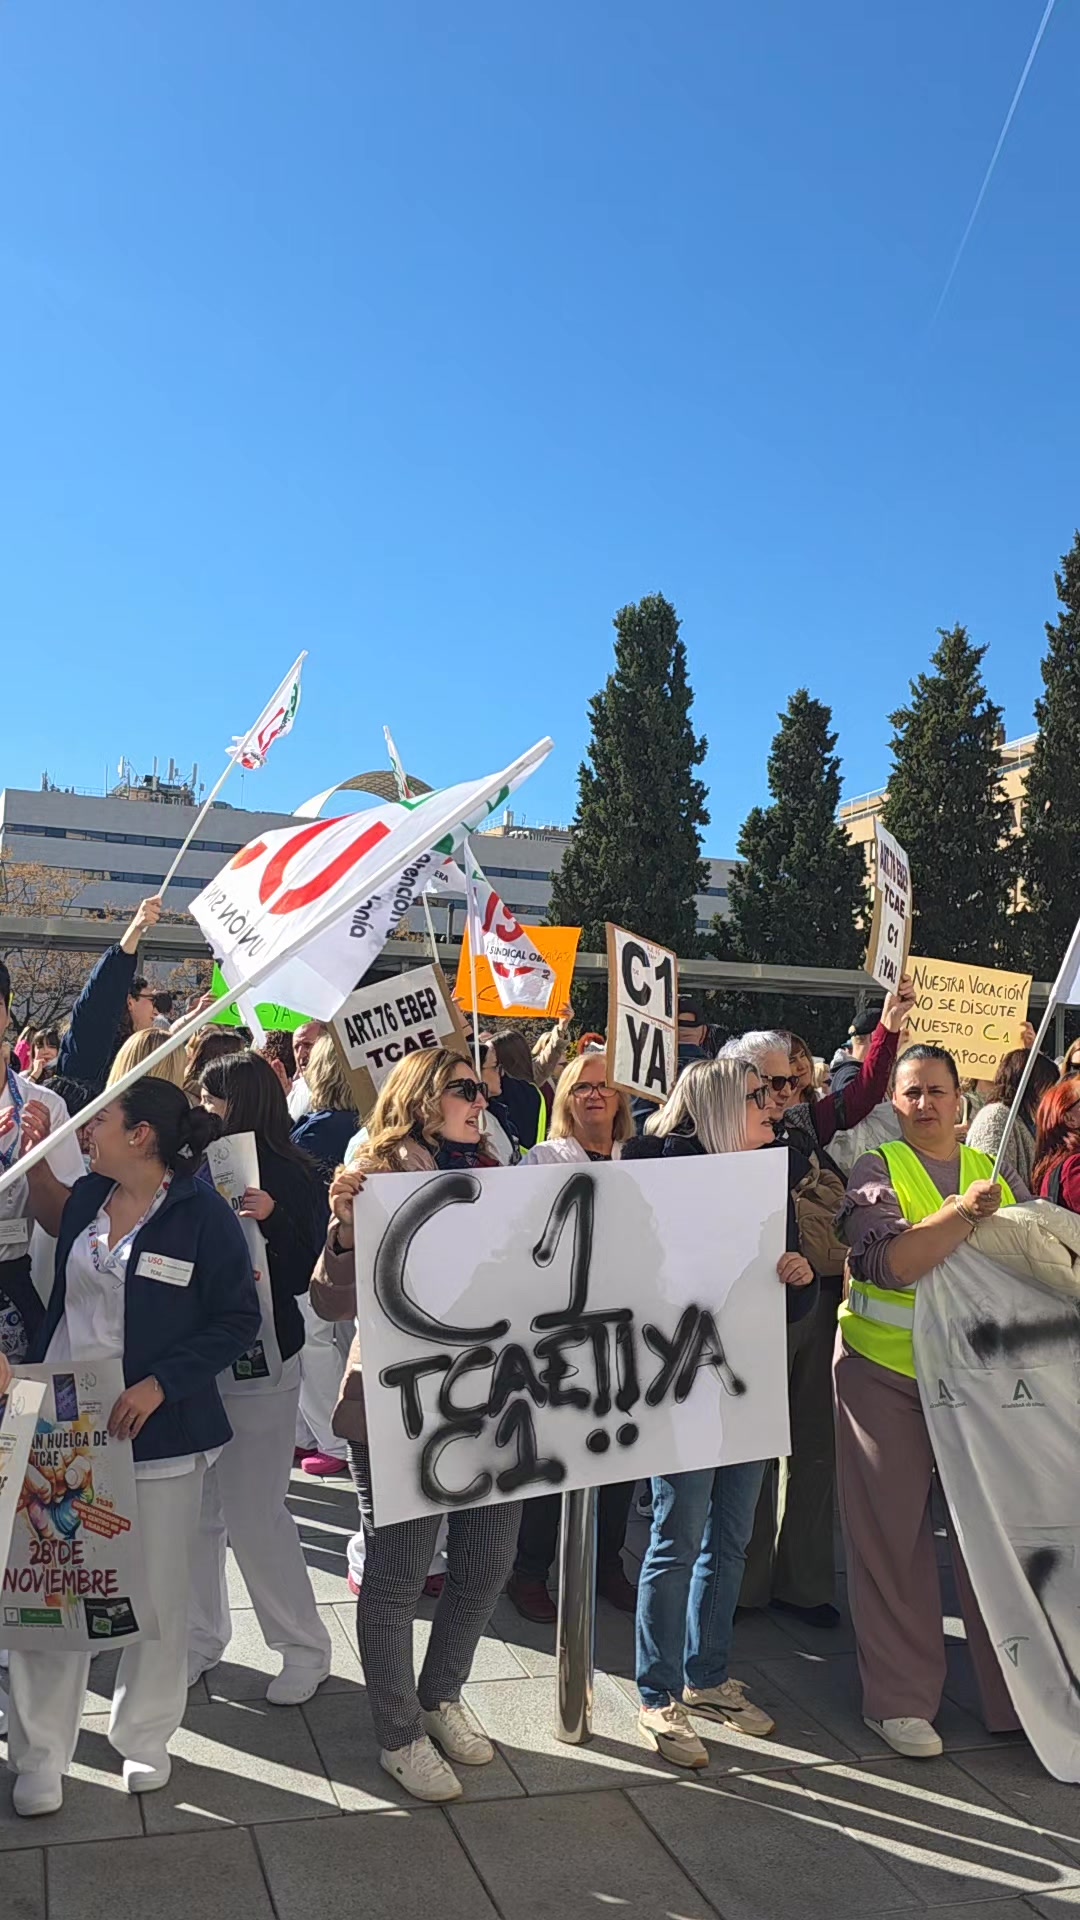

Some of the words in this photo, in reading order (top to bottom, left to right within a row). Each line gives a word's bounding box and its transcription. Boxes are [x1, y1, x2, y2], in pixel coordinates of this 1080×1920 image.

[884, 883, 906, 920] TCAE
[887, 923, 899, 948] C1
[488, 944, 527, 961] SINDICAL
[621, 941, 674, 1019] C1
[878, 955, 898, 985] ¡YA!
[912, 965, 965, 993] NUESTRA
[343, 1001, 399, 1049] ART.76
[394, 986, 438, 1028] EBEP
[938, 999, 957, 1012] SE
[906, 1016, 974, 1036] NUESTRO
[365, 1028, 439, 1069] TCAE
[625, 1013, 669, 1096] YA
[147, 1256, 163, 1266] USO
[641, 1302, 748, 1408] YA
[47, 1430, 90, 1449] HUELGA
[93, 1430, 108, 1446] DE
[419, 1398, 568, 1507] C1
[34, 1450, 59, 1467] TCAE
[29, 1540, 53, 1566] 28
[58, 1540, 85, 1566] DE
[3, 1567, 119, 1598] NOVIEMBRE
